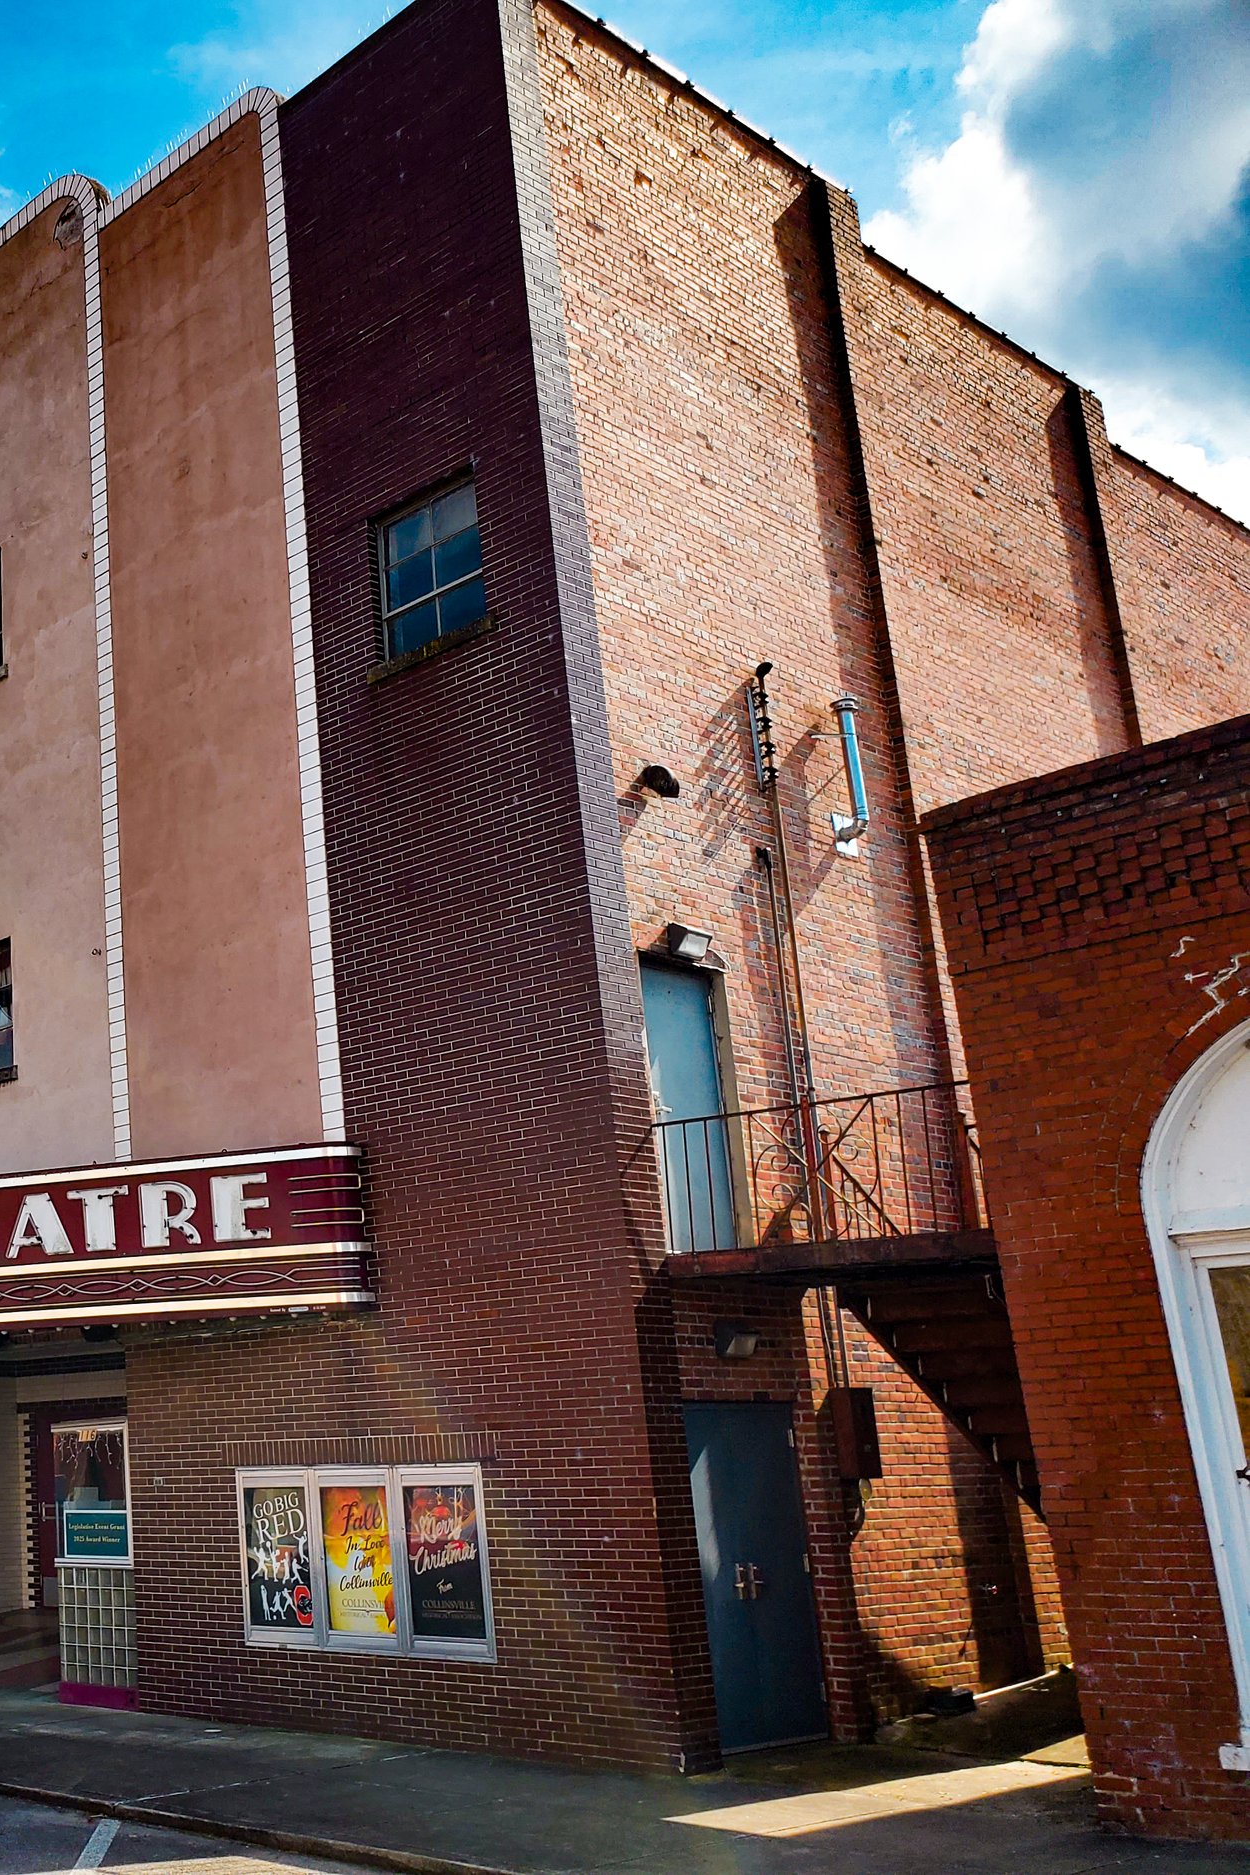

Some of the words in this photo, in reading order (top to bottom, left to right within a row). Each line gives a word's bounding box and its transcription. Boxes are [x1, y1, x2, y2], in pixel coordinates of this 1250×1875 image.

[253, 1500, 273, 1519] GO
[274, 1492, 300, 1513] BIG
[340, 1501, 384, 1537] Fall
[68, 1523, 94, 1531] Legislative
[256, 1508, 305, 1544] RED
[414, 1515, 463, 1544] Merry
[345, 1536, 359, 1555] In
[361, 1535, 385, 1552] Love
[409, 1541, 478, 1576] Christmas
[339, 1571, 394, 1592] Collinsville
[422, 1599, 476, 1611] COLLINSVILLE
